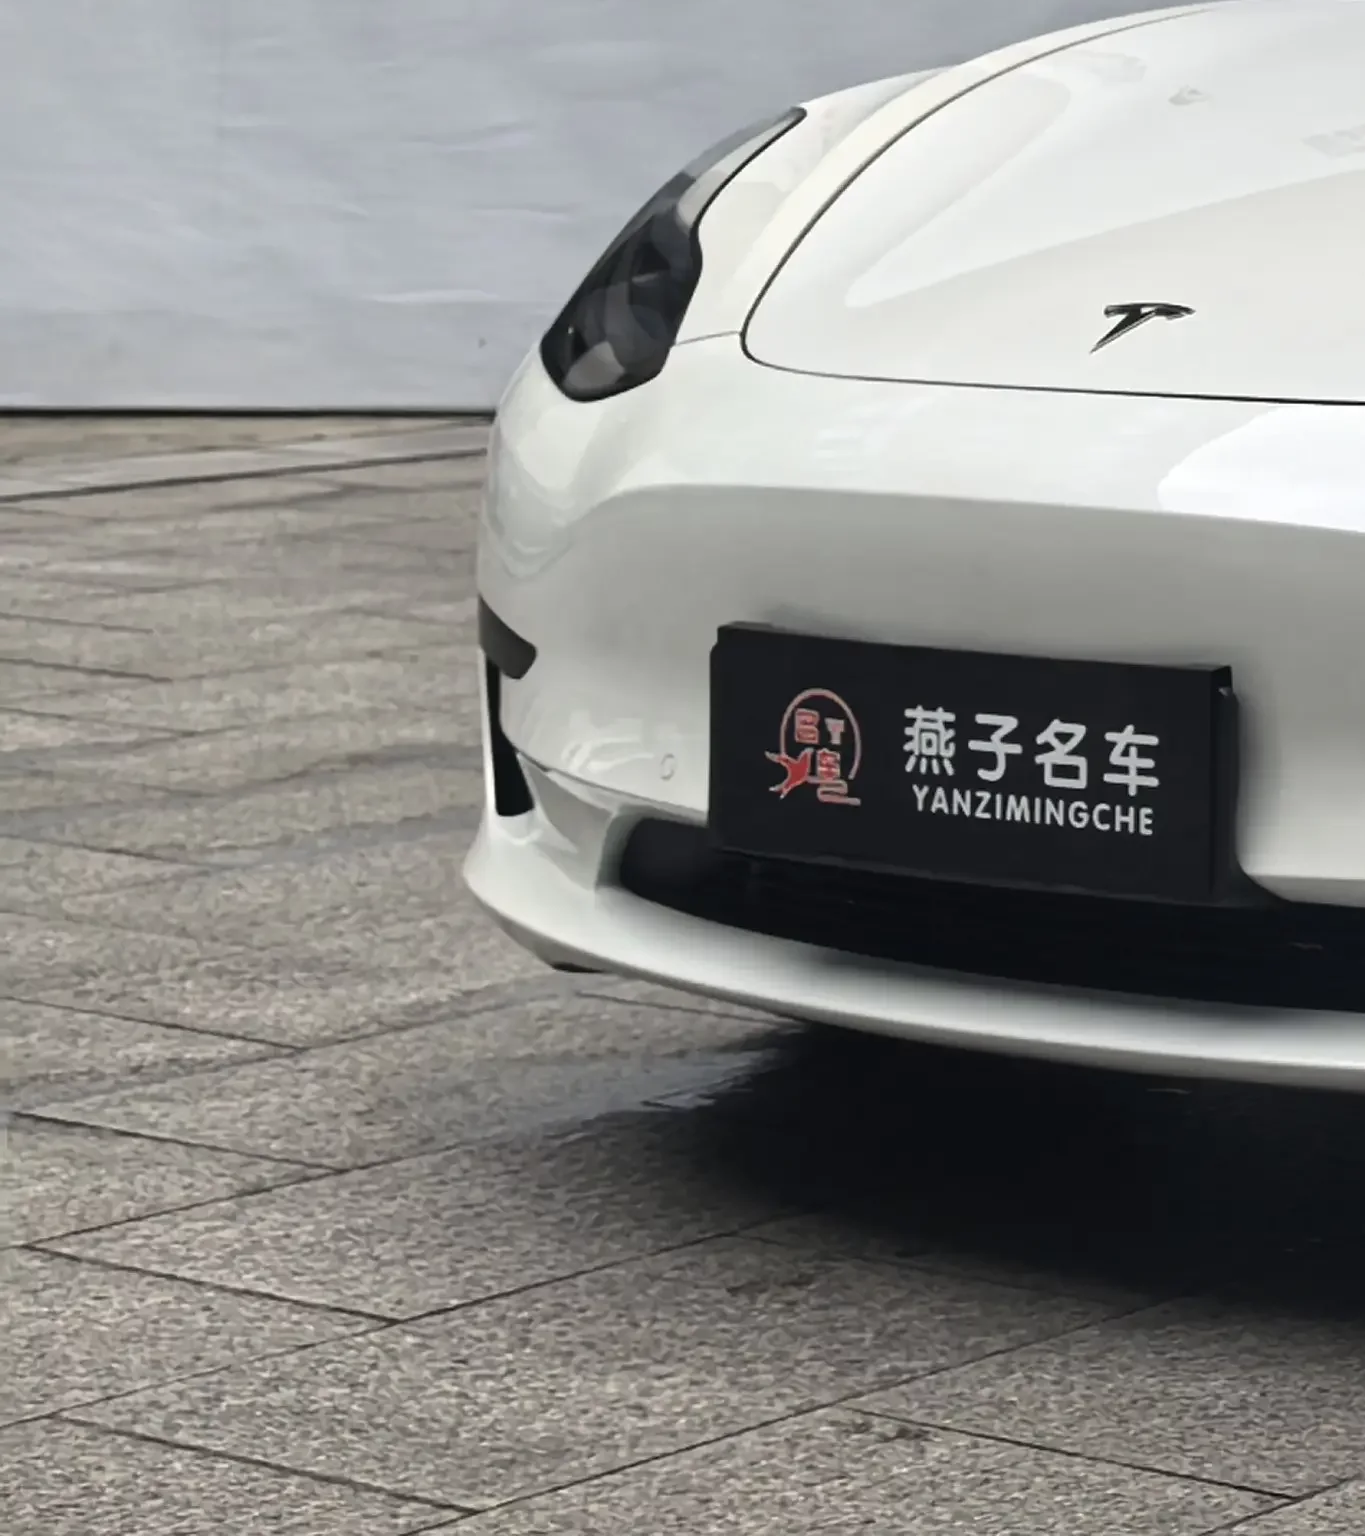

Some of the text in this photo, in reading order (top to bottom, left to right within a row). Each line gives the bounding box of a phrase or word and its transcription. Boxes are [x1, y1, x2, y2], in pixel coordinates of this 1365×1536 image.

[902, 703, 1161, 798] 燕子名车
[911, 782, 1155, 837] YANZIMINGCHE
